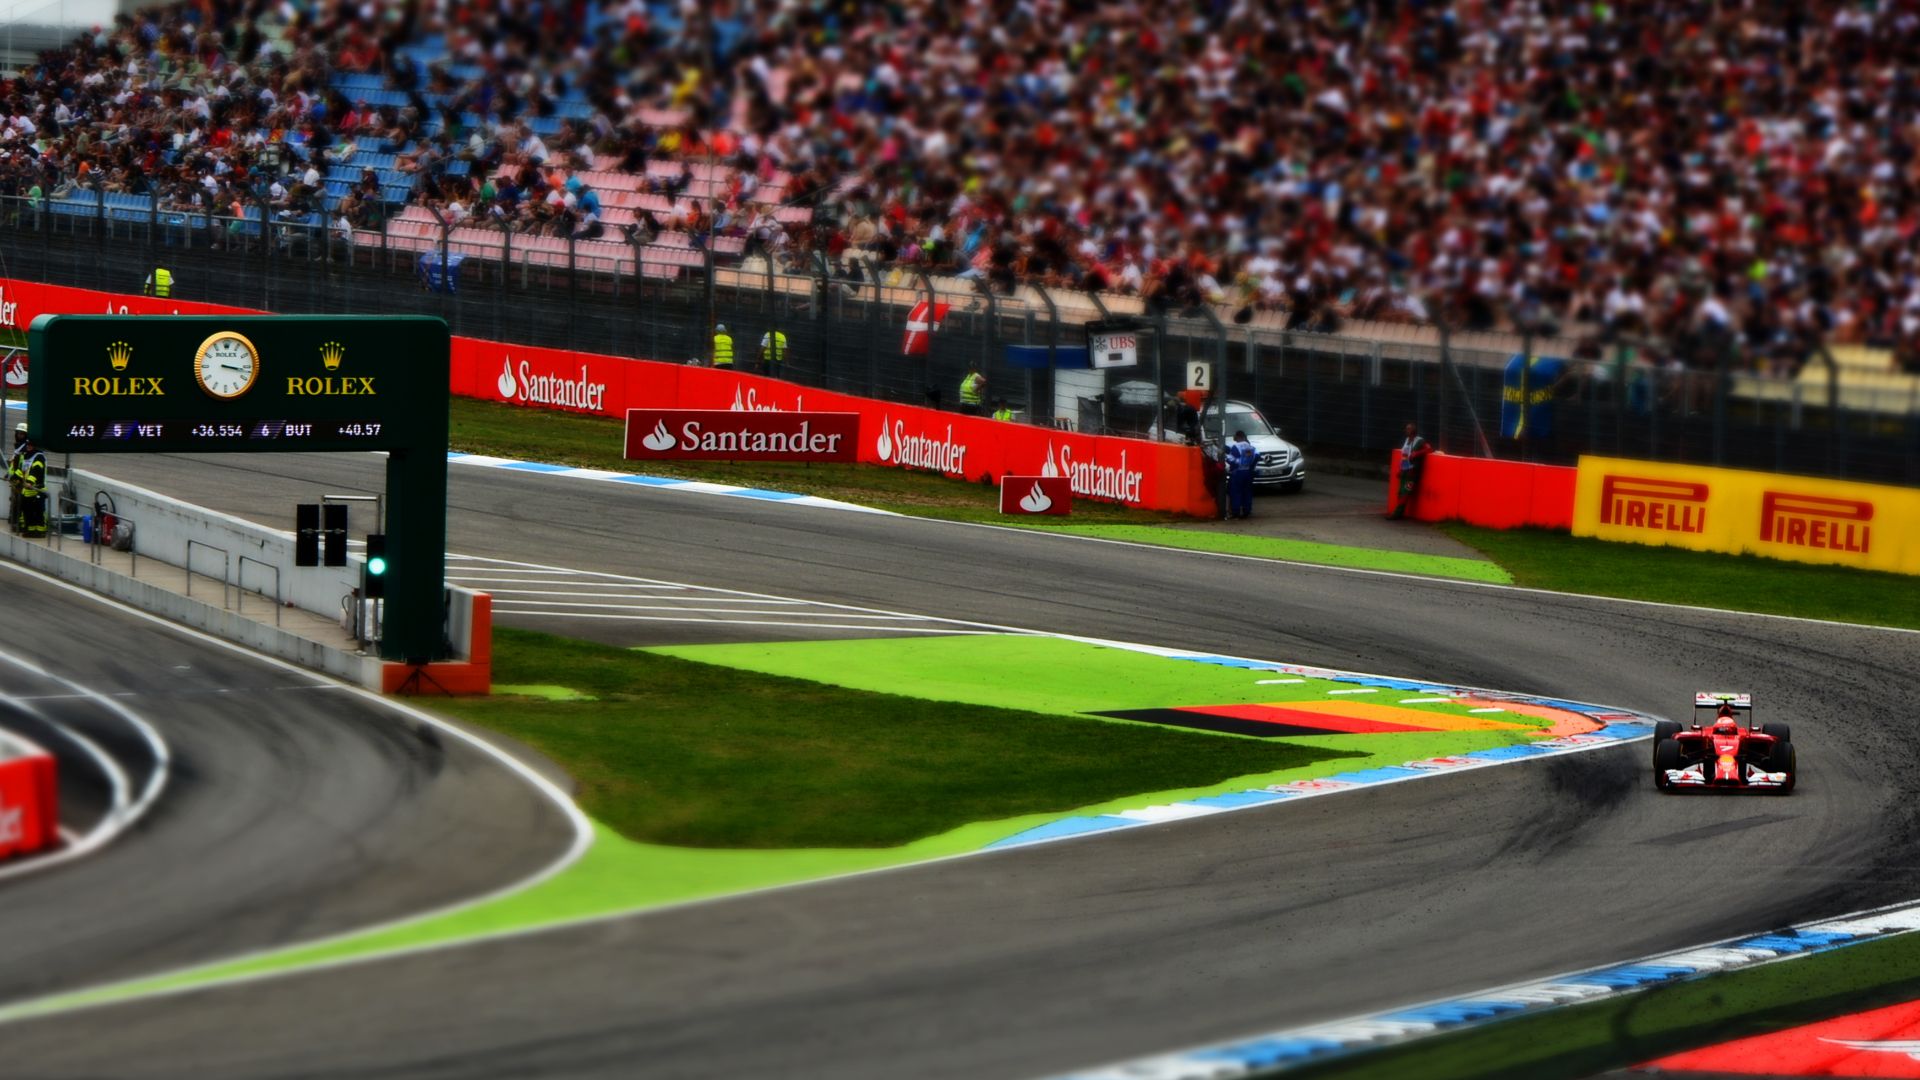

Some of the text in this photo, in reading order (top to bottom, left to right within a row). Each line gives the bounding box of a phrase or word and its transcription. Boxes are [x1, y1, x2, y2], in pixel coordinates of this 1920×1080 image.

[1110, 335, 1136, 350] UBS
[73, 377, 165, 396] ROLEX
[286, 377, 377, 396] ROLEX
[518, 360, 605, 411] Santander
[1194, 366, 1205, 387] 2
[113, 424, 122, 437] 5
[137, 424, 163, 437] VET
[191, 425, 243, 437] +36.554
[261, 424, 270, 437] 6
[285, 424, 312, 437] BUT
[337, 424, 381, 437] +40.57
[680, 421, 842, 454] Santander
[892, 420, 966, 475] Santander
[1060, 444, 1143, 503] Santander
[1600, 474, 1709, 534] PIRELLI
[1759, 491, 1874, 554] PIRELLI
